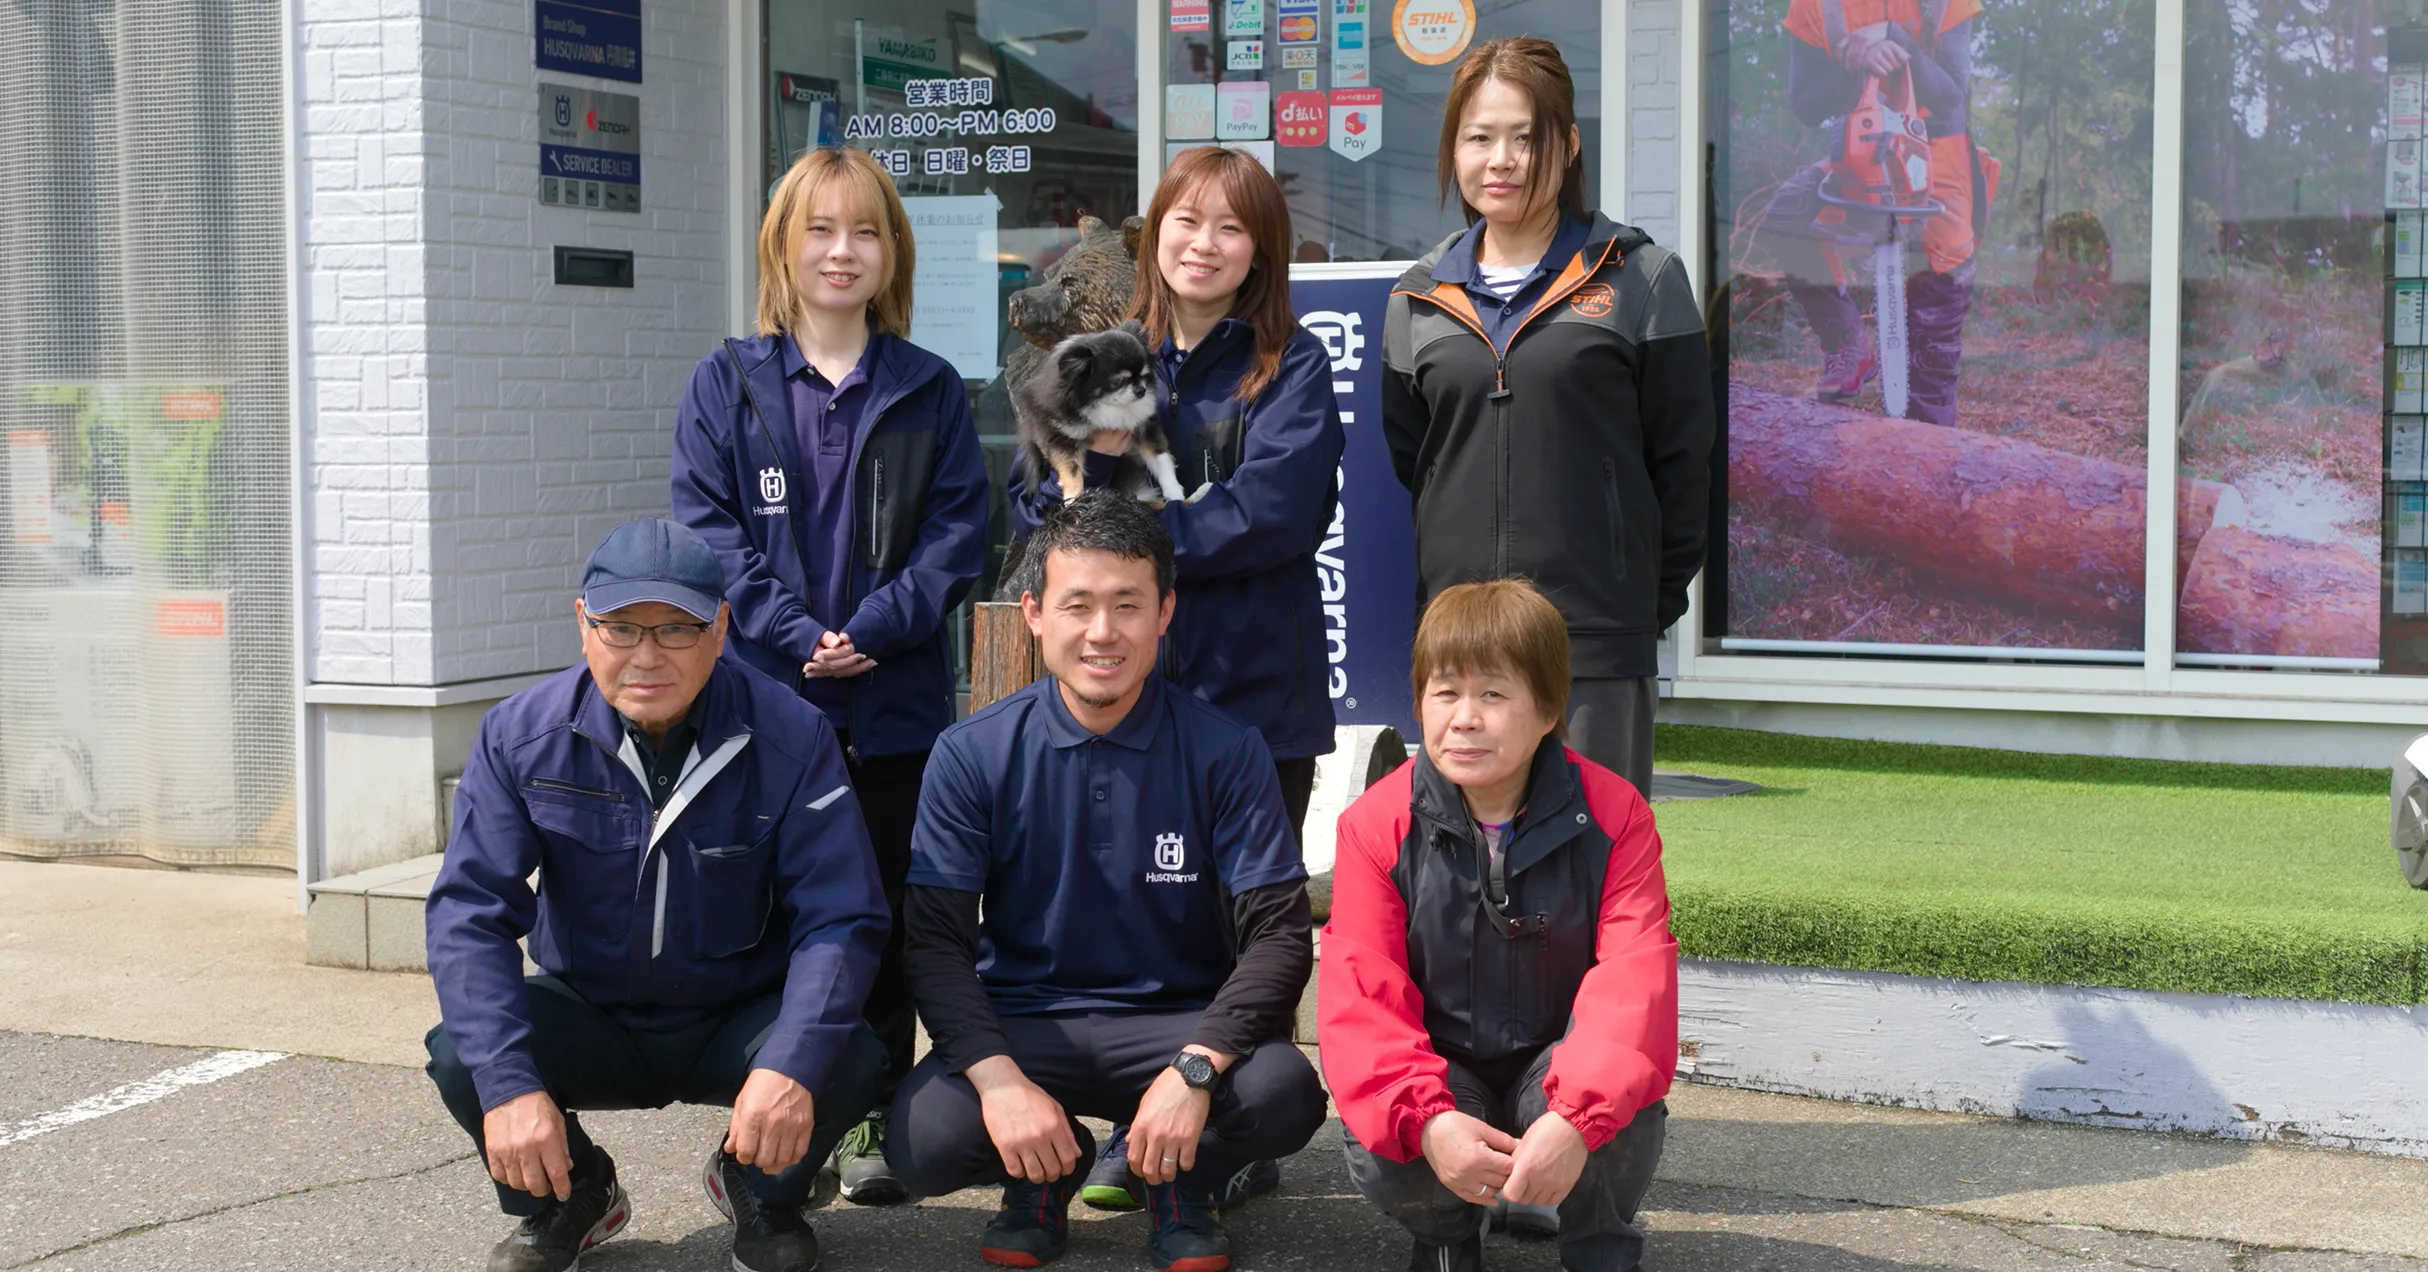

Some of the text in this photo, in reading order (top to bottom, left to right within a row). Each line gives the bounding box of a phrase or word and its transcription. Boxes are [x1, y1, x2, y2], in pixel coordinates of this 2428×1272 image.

[1408, 11, 1458, 26] STIHL
[544, 38, 605, 65] HUSQVARNA
[1232, 52, 1252, 60] JCB
[906, 79, 992, 106] 営業時間
[847, 115, 883, 138] AM
[1003, 109, 1055, 132] 6:00
[1227, 123, 1258, 132] PayPay
[1344, 137, 1367, 150] Pay
[563, 154, 632, 176] SERVICE DEALER
[1571, 295, 1613, 306] STIHL
[1146, 872, 1198, 883] Husqvarna
